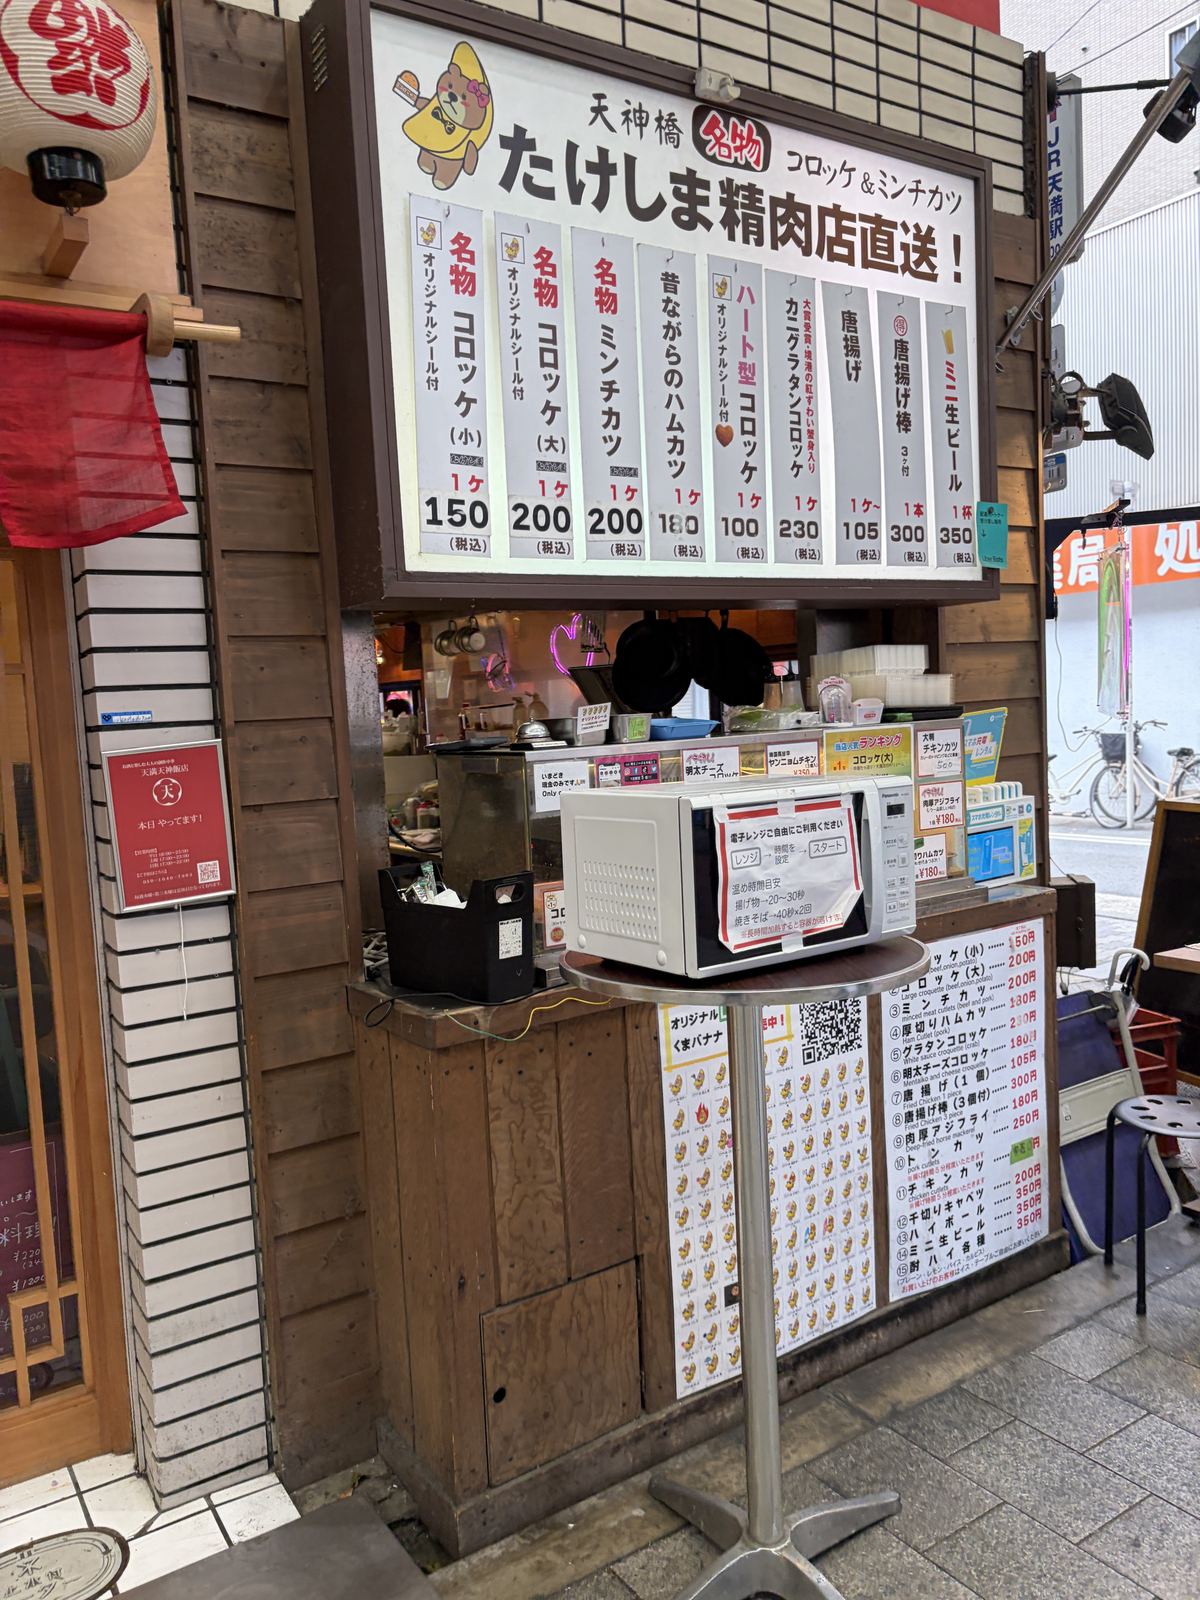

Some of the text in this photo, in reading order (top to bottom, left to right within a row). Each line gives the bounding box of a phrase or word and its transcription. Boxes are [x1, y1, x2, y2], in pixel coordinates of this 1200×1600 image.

[588, 92, 684, 149] 天神橋
[699, 110, 766, 171] 名物
[498, 122, 962, 284] たけしま精肉店直送!
[449, 231, 477, 297] 名物
[533, 246, 558, 309] 名物
[422, 252, 439, 392] オリジナルシール付
[507, 267, 524, 401] オリジナルシール付
[593, 257, 622, 457] 名物 ミンチカツ
[840, 310, 862, 384] 唐揚げ
[716, 303, 729, 423] オリジナルシール付
[660, 271, 686, 479] 昔ながらのハムカツ
[736, 285, 758, 484] ハート型 コロッケ
[785, 297, 804, 478] カニグラタンコロッケ
[894, 338, 912, 434] 唐揚げ棒
[944, 360, 962, 492] ミニ生ビール
[451, 473, 484, 493] 1ケ
[538, 480, 568, 499] 1ケ
[610, 484, 638, 502] 1ケ
[675, 488, 701, 505] 1ケ
[737, 492, 762, 509] 1ケ
[795, 496, 818, 512] 1ケ
[424, 496, 489, 529] 150
[512, 502, 571, 533] 200
[904, 502, 924, 518] 1本
[952, 505, 973, 520] 1杯
[587, 507, 643, 535] 200
[721, 517, 759, 538] 100
[779, 519, 819, 540] 230
[843, 521, 879, 541] 105
[890, 524, 925, 543] 300
[939, 527, 973, 545] 350
[449, 537, 487, 553] (税込)
[537, 540, 571, 555] (税込)
[610, 543, 642, 557] (税込)
[673, 545, 703, 559] (税込)
[736, 547, 765, 561] (税込)
[795, 548, 821, 561] (税込)
[856, 549, 881, 562] (税込)
[903, 551, 927, 563] (税込)
[953, 552, 975, 564] (税込)
[923, 742, 958, 754] チキンカツ
[685, 763, 724, 776] 明太チーズ
[769, 755, 817, 767] ヤンニョムチキン
[853, 753, 894, 766] コロッケ(大)
[922, 796, 960, 808] 肉厚アジフライ
[138, 814, 202, 831] 本日 やってます!
[936, 813, 955, 825] ¥180
[730, 821, 844, 843] 電子レンジご自由にご利用ください
[735, 851, 758, 864] レンジ
[813, 841, 842, 854] スタート
[919, 866, 938, 879] ¥180
[732, 877, 781, 896] 温め時間目安
[1008, 950, 1036, 968] 200円
[1008, 970, 1037, 990] 200円
[902, 992, 918, 1001] Large
[919, 986, 945, 997] croquette
[1010, 990, 1036, 1009] 180円
[671, 1006, 718, 1030] オリジナル
[902, 1012, 922, 1023] minced
[923, 1009, 937, 1018] meat
[937, 1004, 956, 1014] cutlets
[971, 998, 981, 1007] and
[674, 1030, 723, 1053] くまバナナ
[902, 1037, 916, 1045] Ham
[916, 1033, 933, 1042] Cutlet
[902, 1027, 987, 1058] グラタンコロッケ
[902, 1048, 988, 1080] 明太チーズコロッケ
[903, 1056, 919, 1066] White
[920, 1052, 937, 1061] sauce
[937, 1046, 965, 1057] croquette
[1010, 1049, 1037, 1069] 105円
[929, 1072, 940, 1080] and
[941, 1068, 961, 1078] cheese
[1011, 1069, 1037, 1089] 300円
[903, 1089, 962, 1110] Fried Chicken piece
[1011, 1089, 1038, 1110] 180円
[904, 1110, 964, 1132] Fried Chicken piece
[1013, 1109, 1040, 1130] 250円
[936, 1134, 952, 1144] horse
[908, 1158, 940, 1174] pork cutlets
[1014, 1163, 1041, 1185] 200円
[908, 1185, 949, 1203] chicken cutlets
[1015, 1178, 1042, 1199] 350円
[1016, 1193, 1042, 1215] 350円
[1017, 1207, 1042, 1229] 350円
